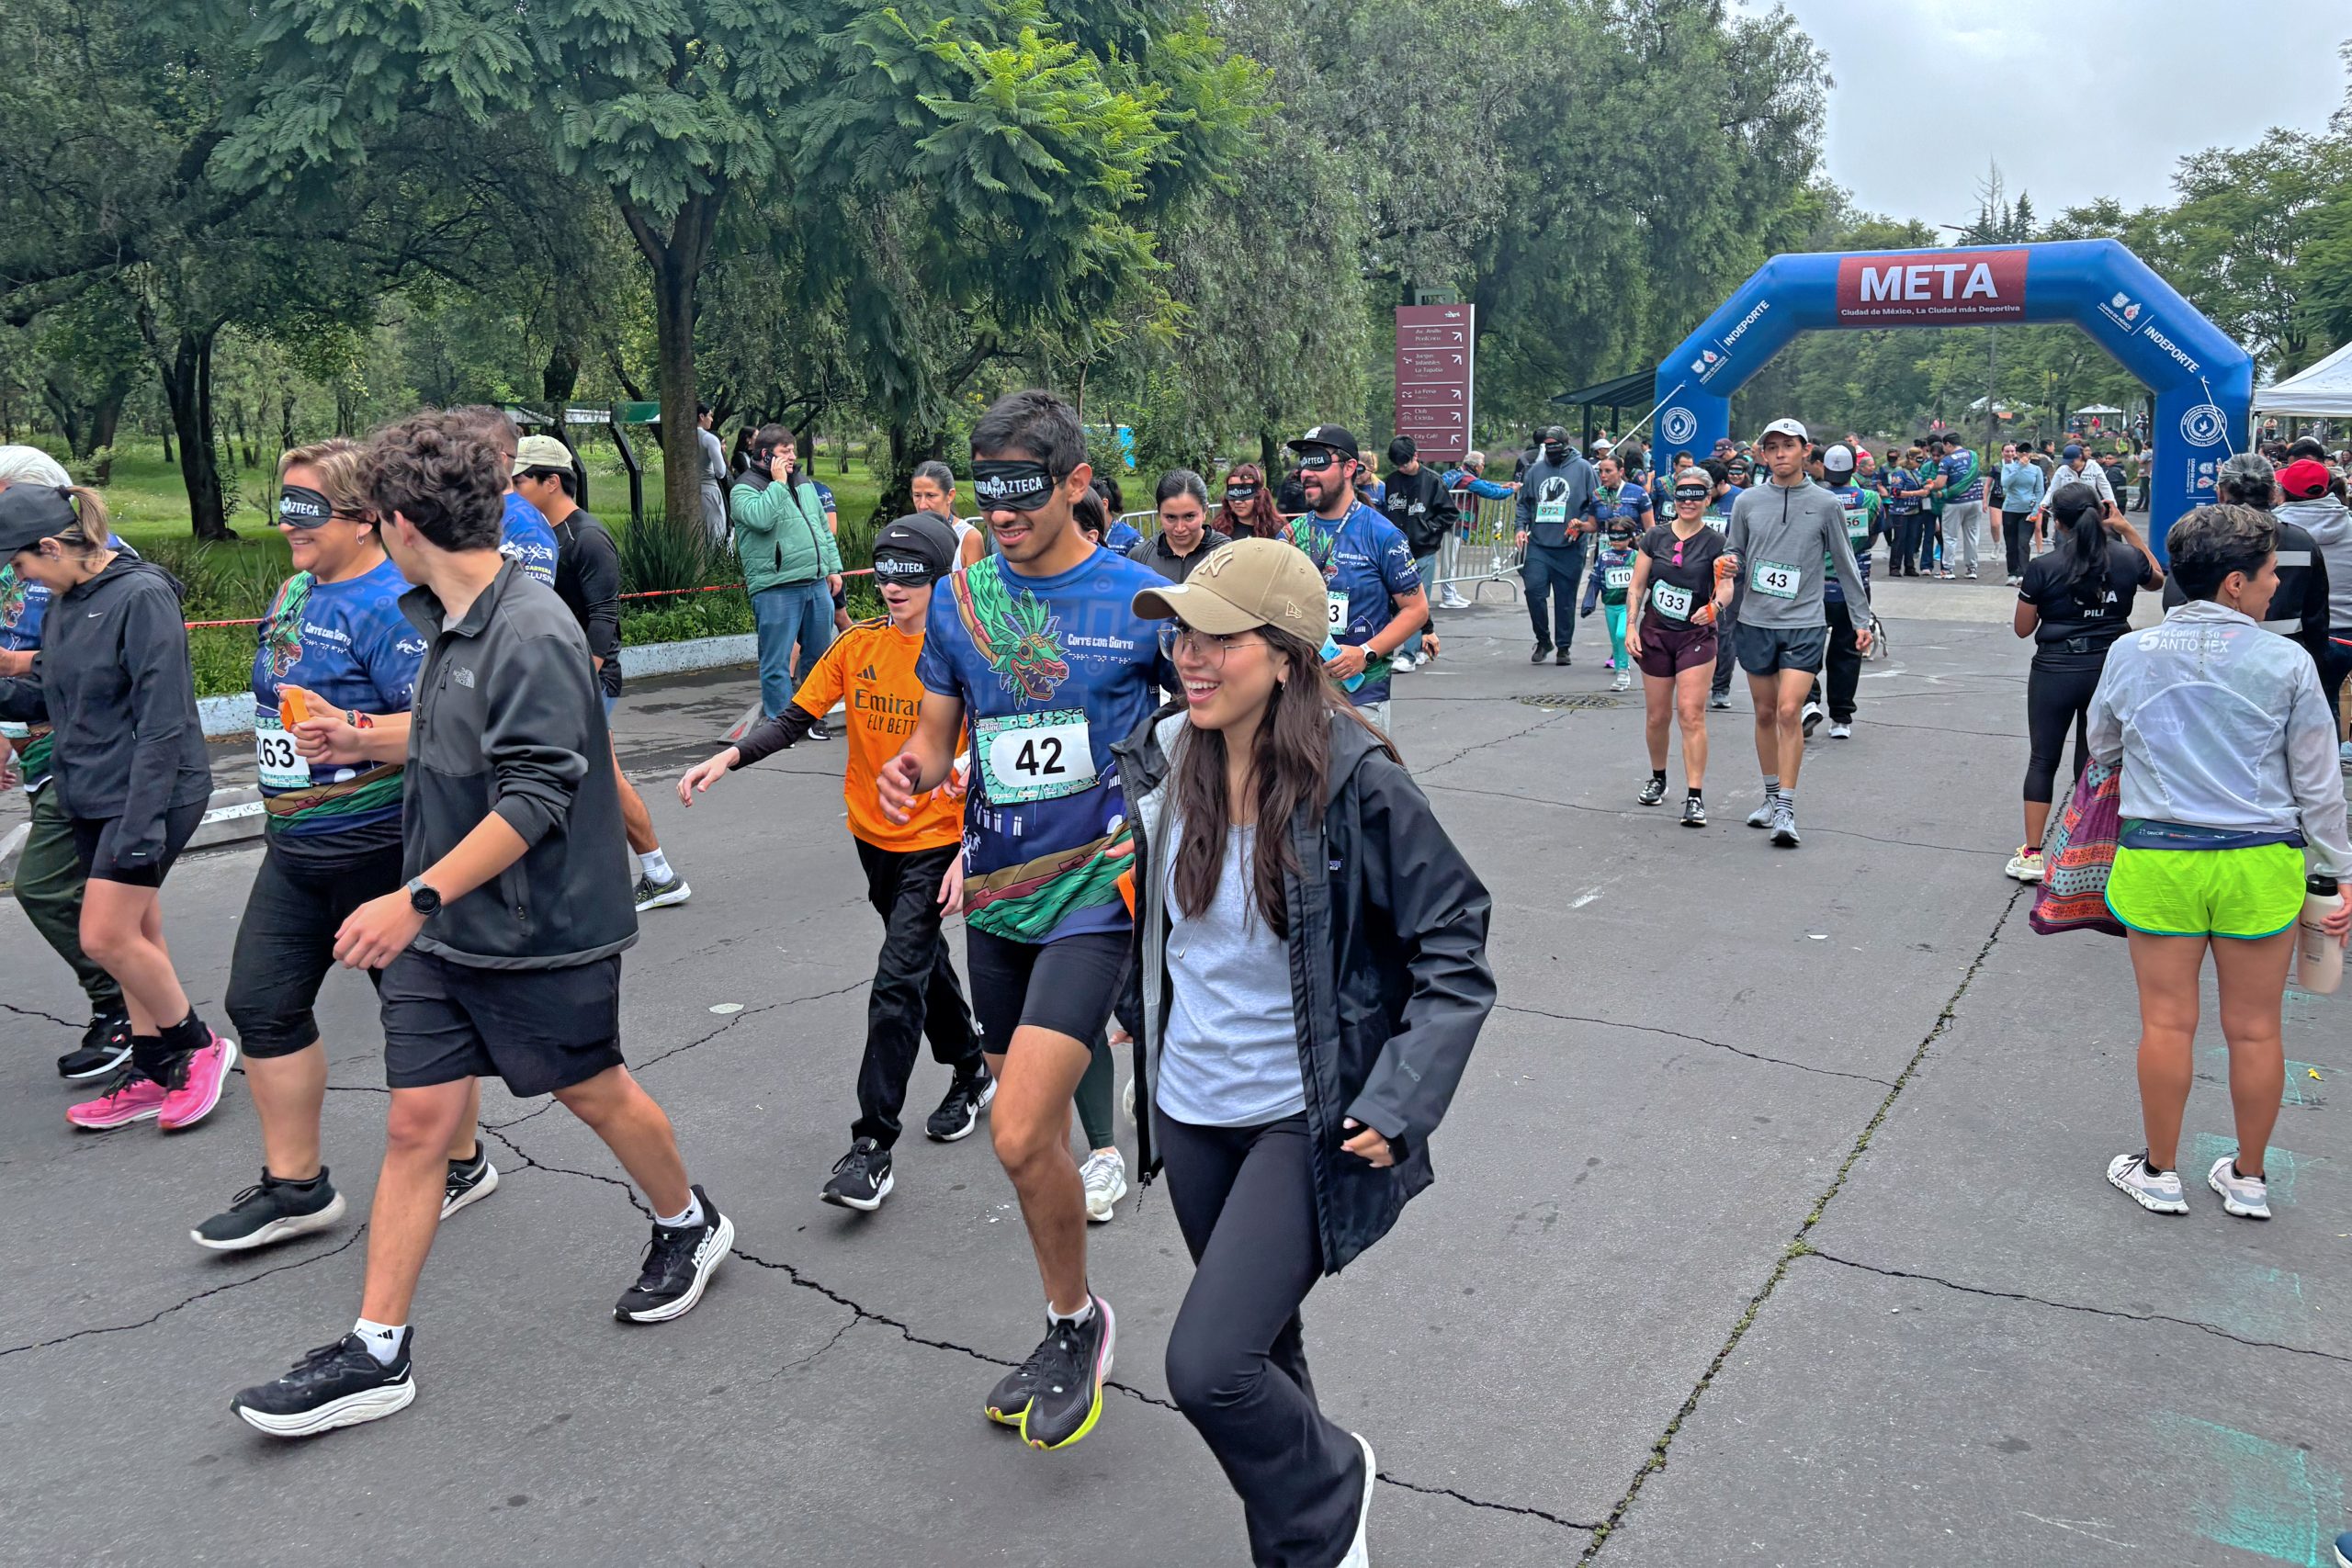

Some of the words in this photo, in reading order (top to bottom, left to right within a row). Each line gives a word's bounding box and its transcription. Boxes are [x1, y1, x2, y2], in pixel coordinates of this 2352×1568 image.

[1860, 263, 1998, 302] META
[1883, 308, 1915, 317] México,
[1928, 306, 1957, 314] Ciudad
[1978, 305, 2020, 313] Deportiva
[1723, 299, 1770, 346] INDEPORTE
[2143, 325, 2200, 374] INDEPORTE
[1000, 476, 1044, 494] AZTECA
[893, 562, 924, 573] AZTECA
[1611, 572, 1631, 582] 110
[1766, 571, 1787, 588] 43
[1658, 591, 1685, 611] 133
[1068, 633, 1091, 647] Corre
[1091, 637, 1108, 648] con
[1109, 636, 1135, 650] Garra
[866, 713, 885, 731] FLY
[1015, 737, 1066, 776] 42
[691, 1224, 715, 1269] HOKA
